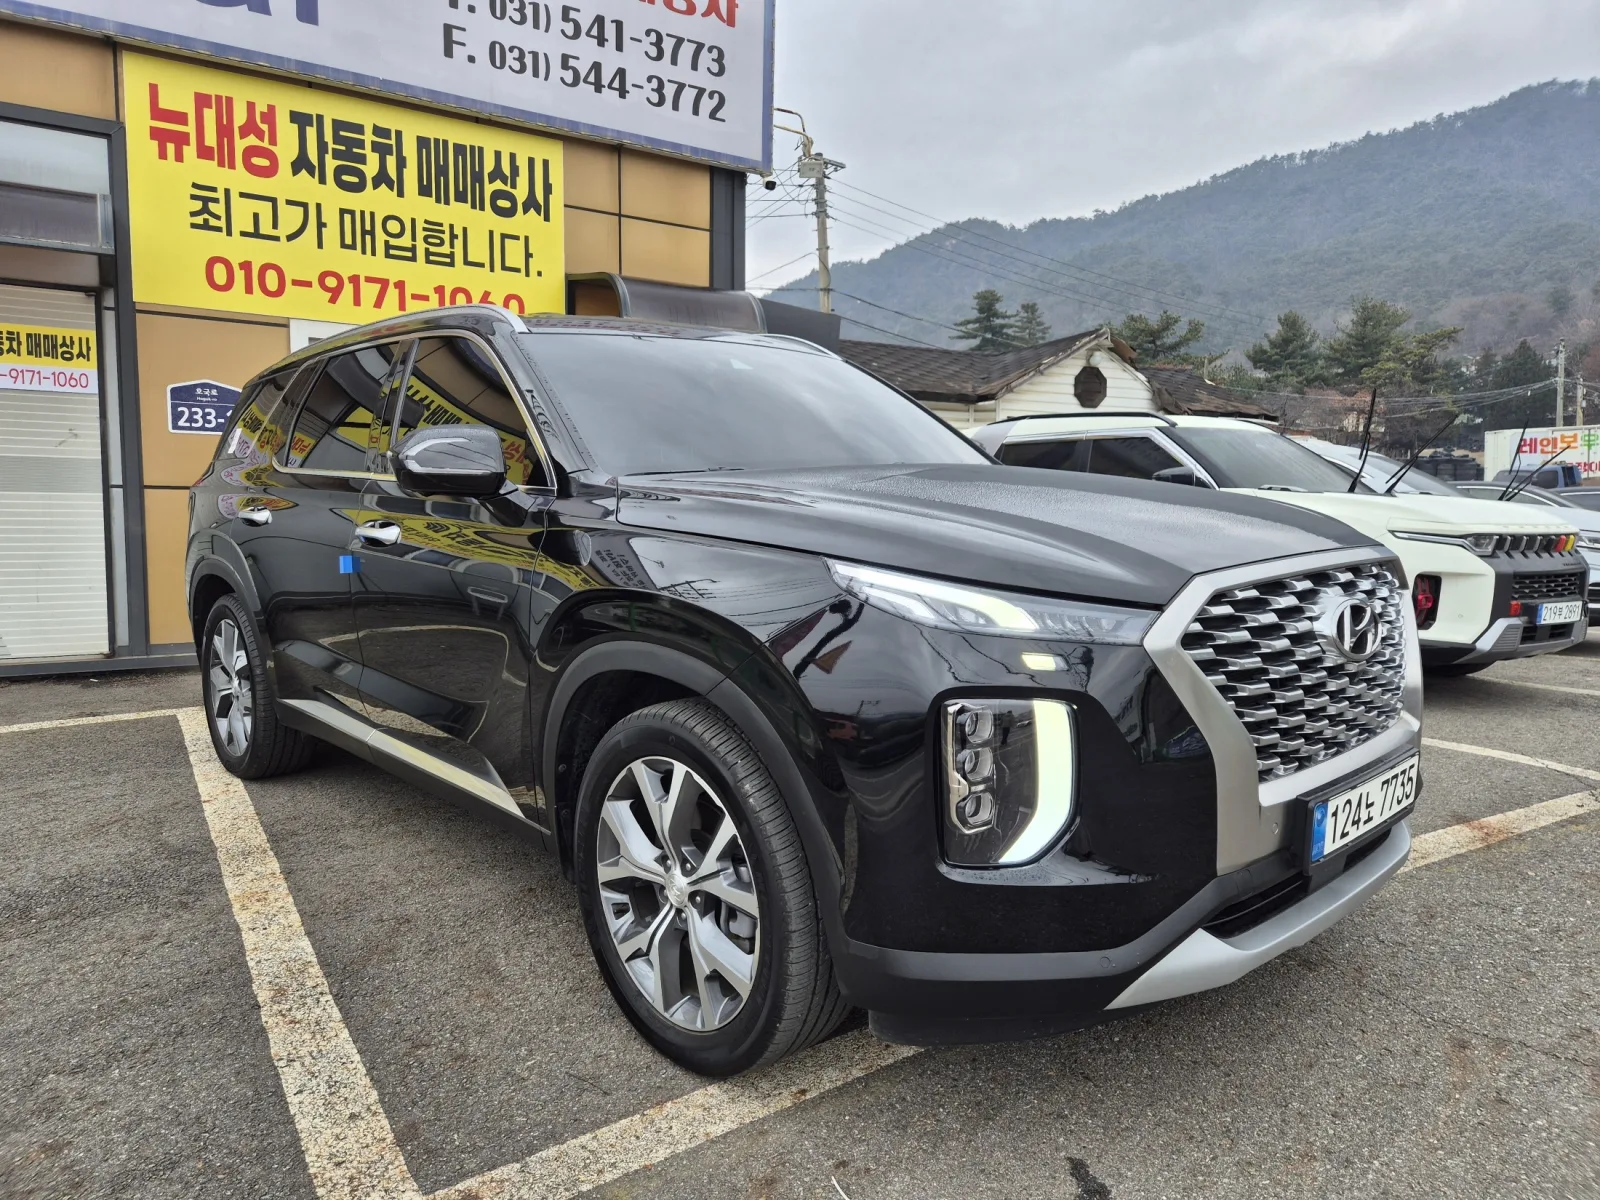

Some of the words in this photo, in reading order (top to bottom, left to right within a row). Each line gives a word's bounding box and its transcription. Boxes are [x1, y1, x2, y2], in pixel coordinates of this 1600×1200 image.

[443, 23, 476, 64] F.
[488, 40, 551, 82] 031)
[559, 53, 726, 123] 544-3772
[489, 0, 552, 33] 031)
[560, 4, 726, 78] 541-3773
[148, 82, 280, 179] 뉴대성
[289, 110, 407, 198] 자동차
[416, 135, 553, 222] 매매상사
[189, 182, 328, 250] 최고가
[338, 207, 543, 278] 매입합니다.
[26, 332, 92, 362] 매매상사
[1564, 603, 1580, 620] 2891
[1331, 791, 1375, 844] 124노
[1380, 763, 1415, 817] 7735
